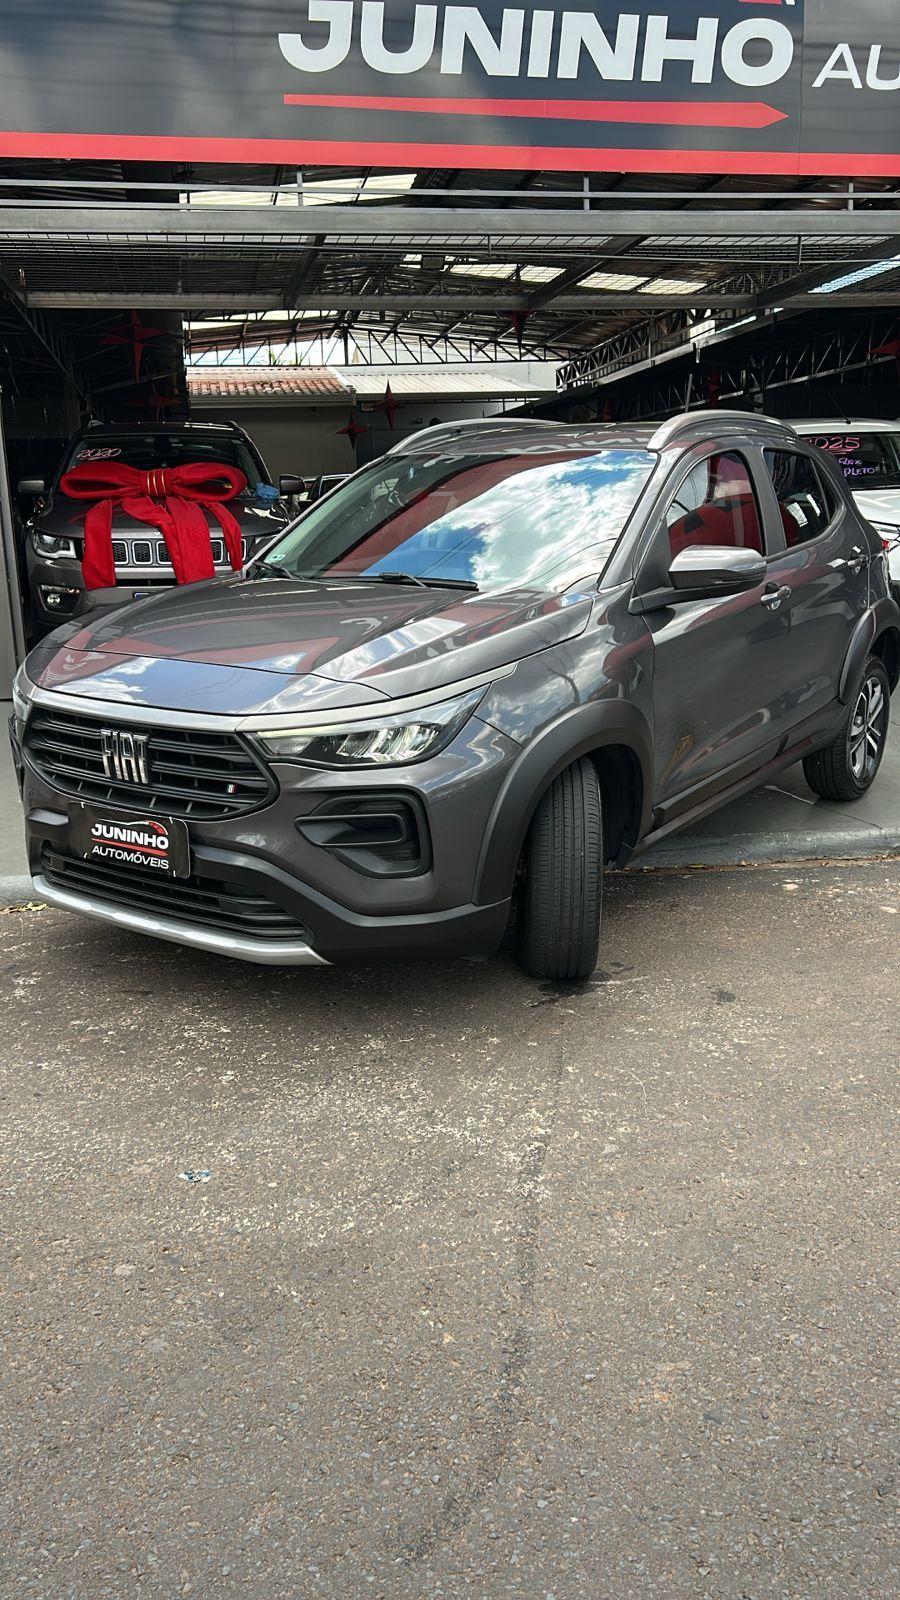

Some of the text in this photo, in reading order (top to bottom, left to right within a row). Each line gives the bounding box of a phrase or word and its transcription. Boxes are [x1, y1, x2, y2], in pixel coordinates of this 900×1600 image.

[278, 0, 900, 91] JUNINHO AU
[76, 447, 122, 458] 2020
[100, 728, 149, 784] FIAT
[91, 823, 169, 850] JUNINHO
[92, 845, 170, 869] AUTOMÓVEIS
